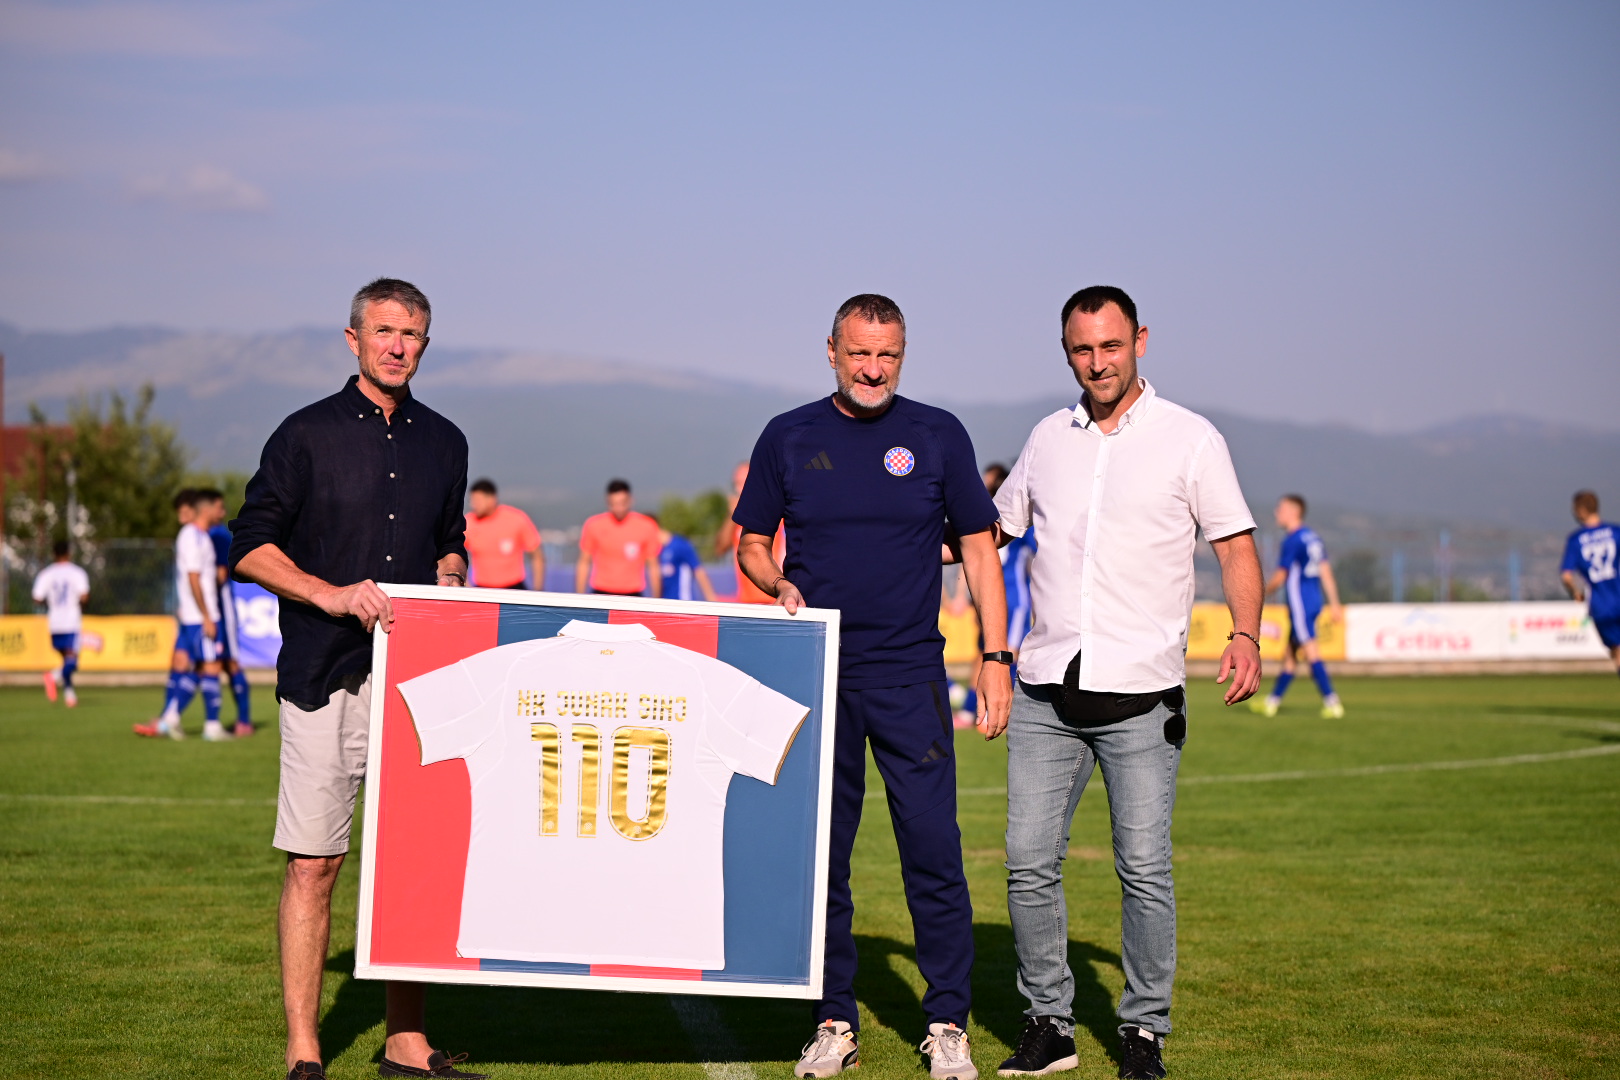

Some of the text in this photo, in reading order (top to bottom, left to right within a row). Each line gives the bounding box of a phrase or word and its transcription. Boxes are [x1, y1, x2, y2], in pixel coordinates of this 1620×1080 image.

[887, 448, 912, 458] HAJDUK
[889, 467, 909, 475] SPLIT
[517, 690, 687, 722] NK JUNAK SINJ
[530, 722, 672, 841] 110
